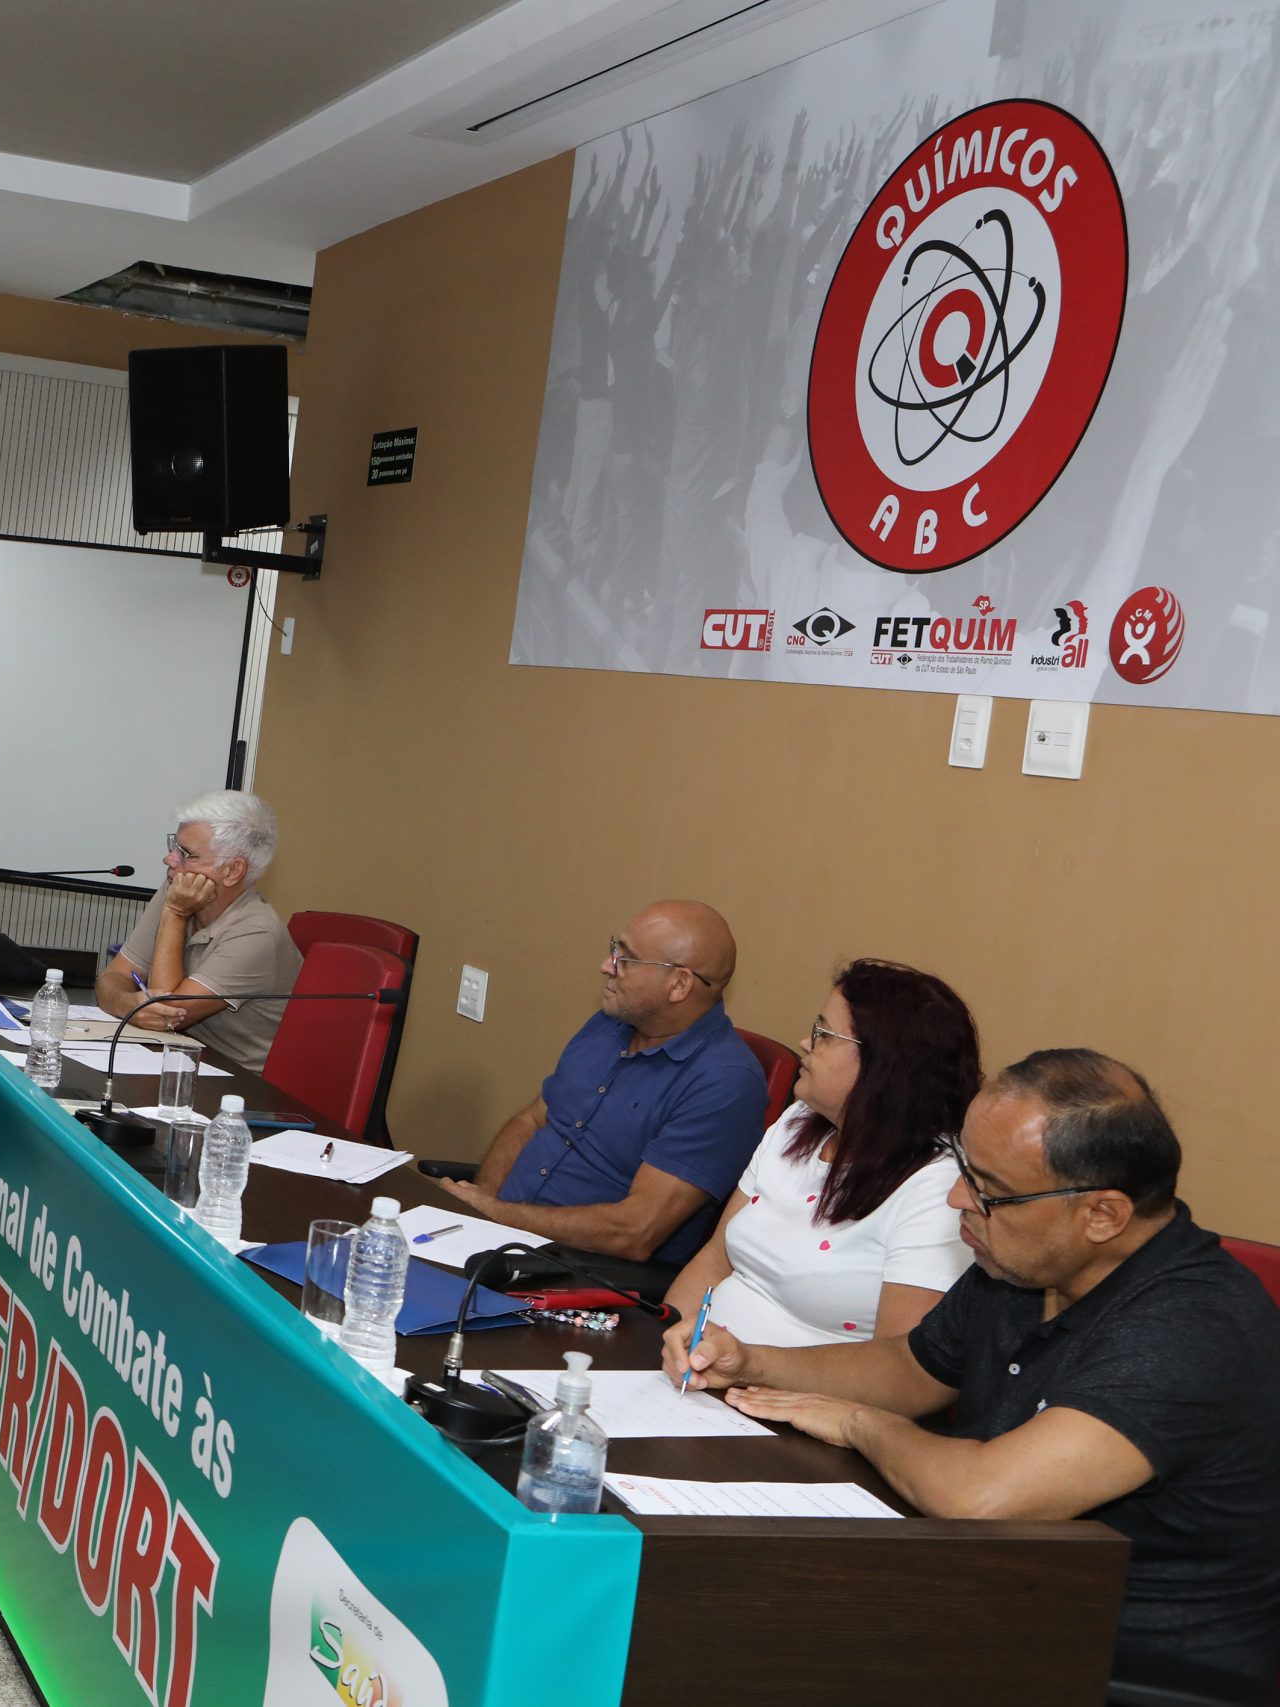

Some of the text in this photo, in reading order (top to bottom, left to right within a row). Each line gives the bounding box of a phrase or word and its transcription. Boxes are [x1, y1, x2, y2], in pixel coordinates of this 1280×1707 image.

[876, 126, 1078, 250] QUÍMICOS
[978, 600, 989, 610] SP
[702, 613, 767, 649] CUT
[764, 609, 776, 651] BRASIL
[786, 635, 806, 646] CNQ
[873, 616, 1017, 653] FETQUIM
[871, 654, 890, 665] CUT
[946, 655, 973, 664] Trabalhadores
[1061, 638, 1089, 669] all
[29, 1204, 58, 1292] de
[62, 1235, 183, 1438] Combate
[191, 1371, 235, 1499] às
